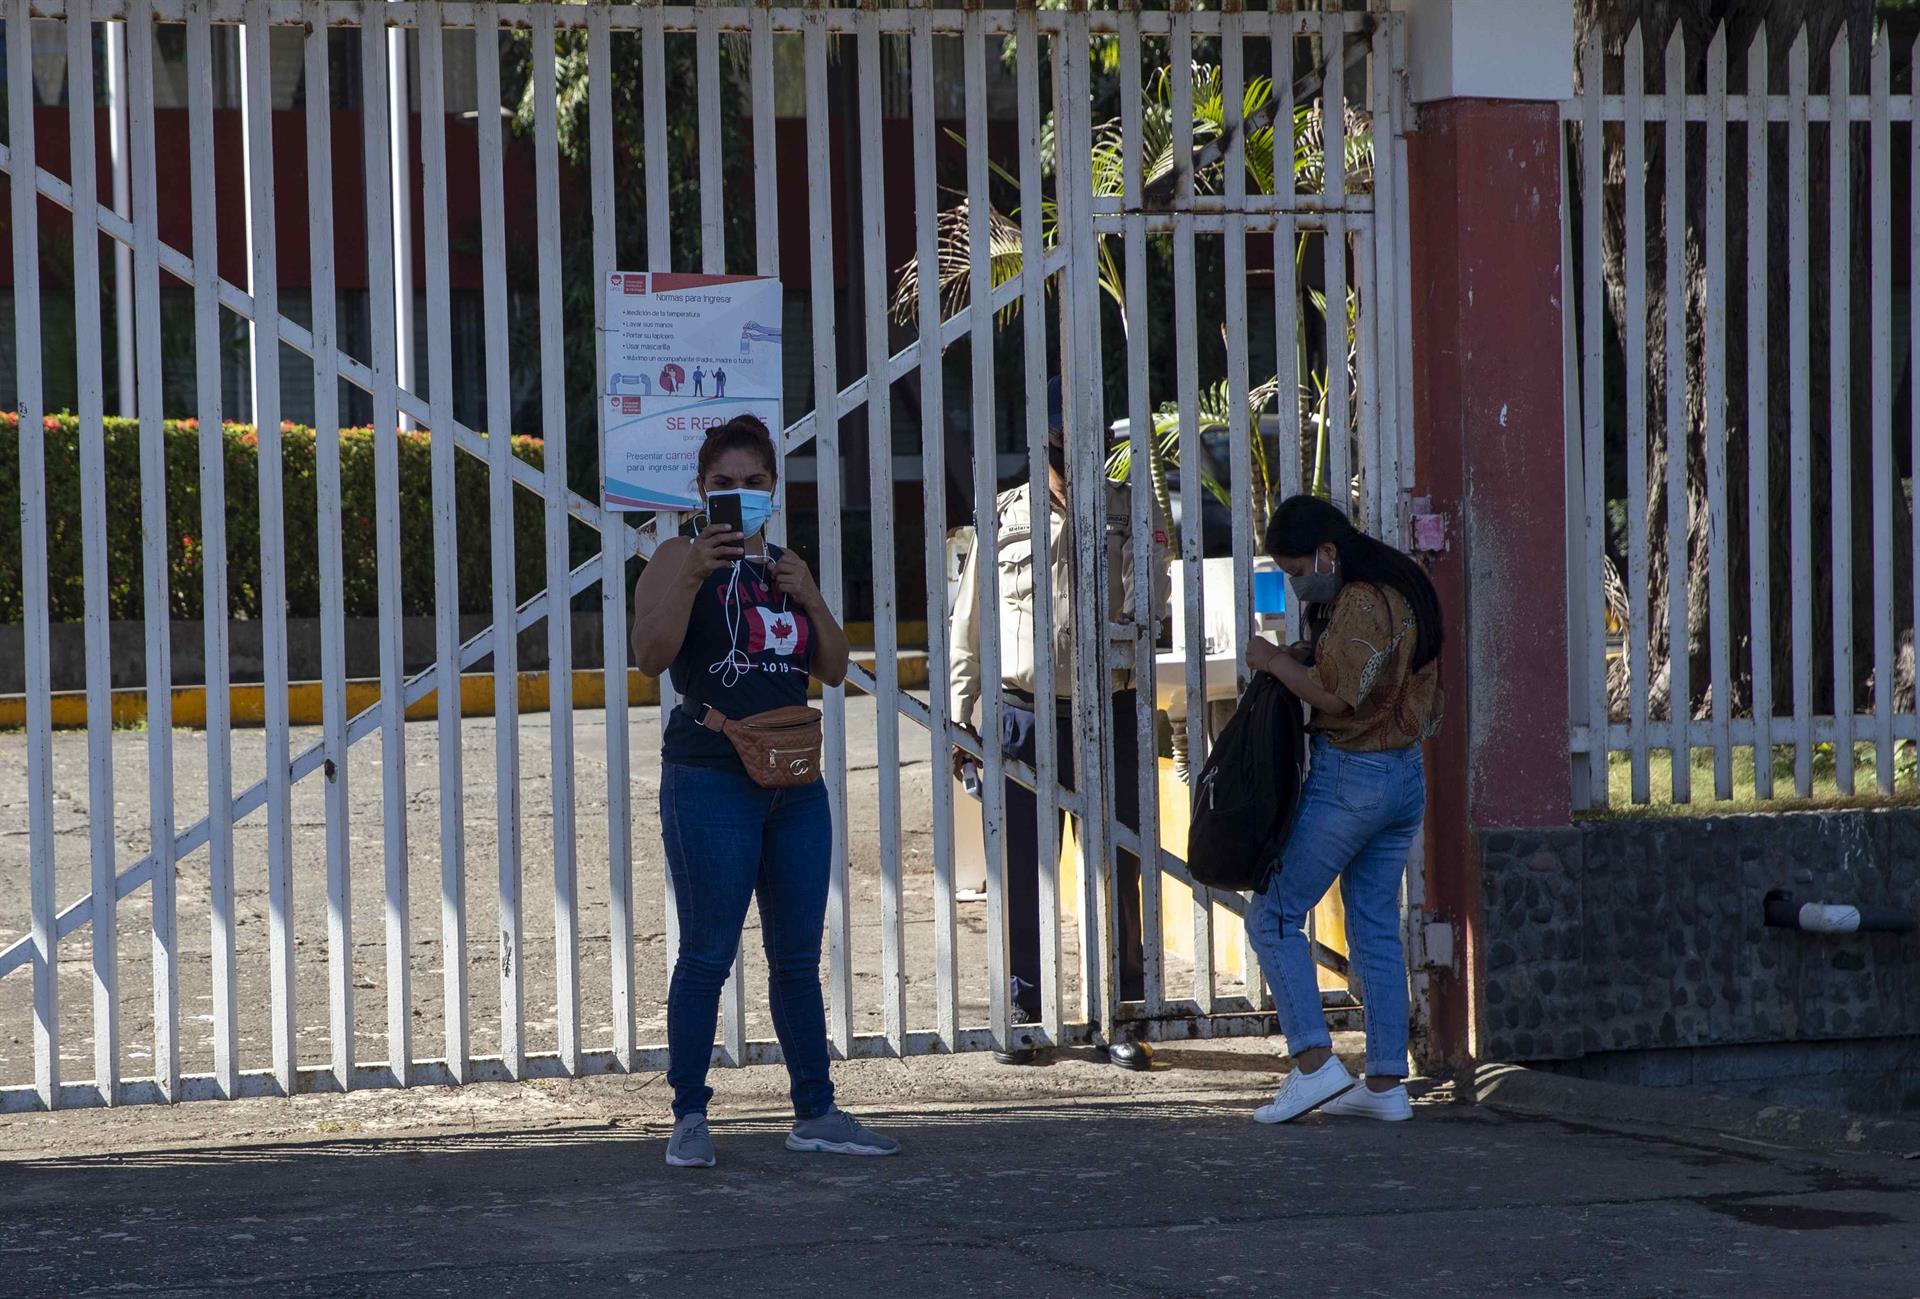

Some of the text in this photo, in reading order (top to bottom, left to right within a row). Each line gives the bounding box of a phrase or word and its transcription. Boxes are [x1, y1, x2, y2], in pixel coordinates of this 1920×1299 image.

[656, 293, 683, 302] Normas
[685, 295, 701, 304] para
[667, 310, 701, 318] temperatura
[666, 416, 686, 431] SE
[626, 450, 696, 460] Presentar carnet
[626, 463, 645, 473] para
[648, 463, 679, 473] ingresar
[681, 463, 689, 471] al
